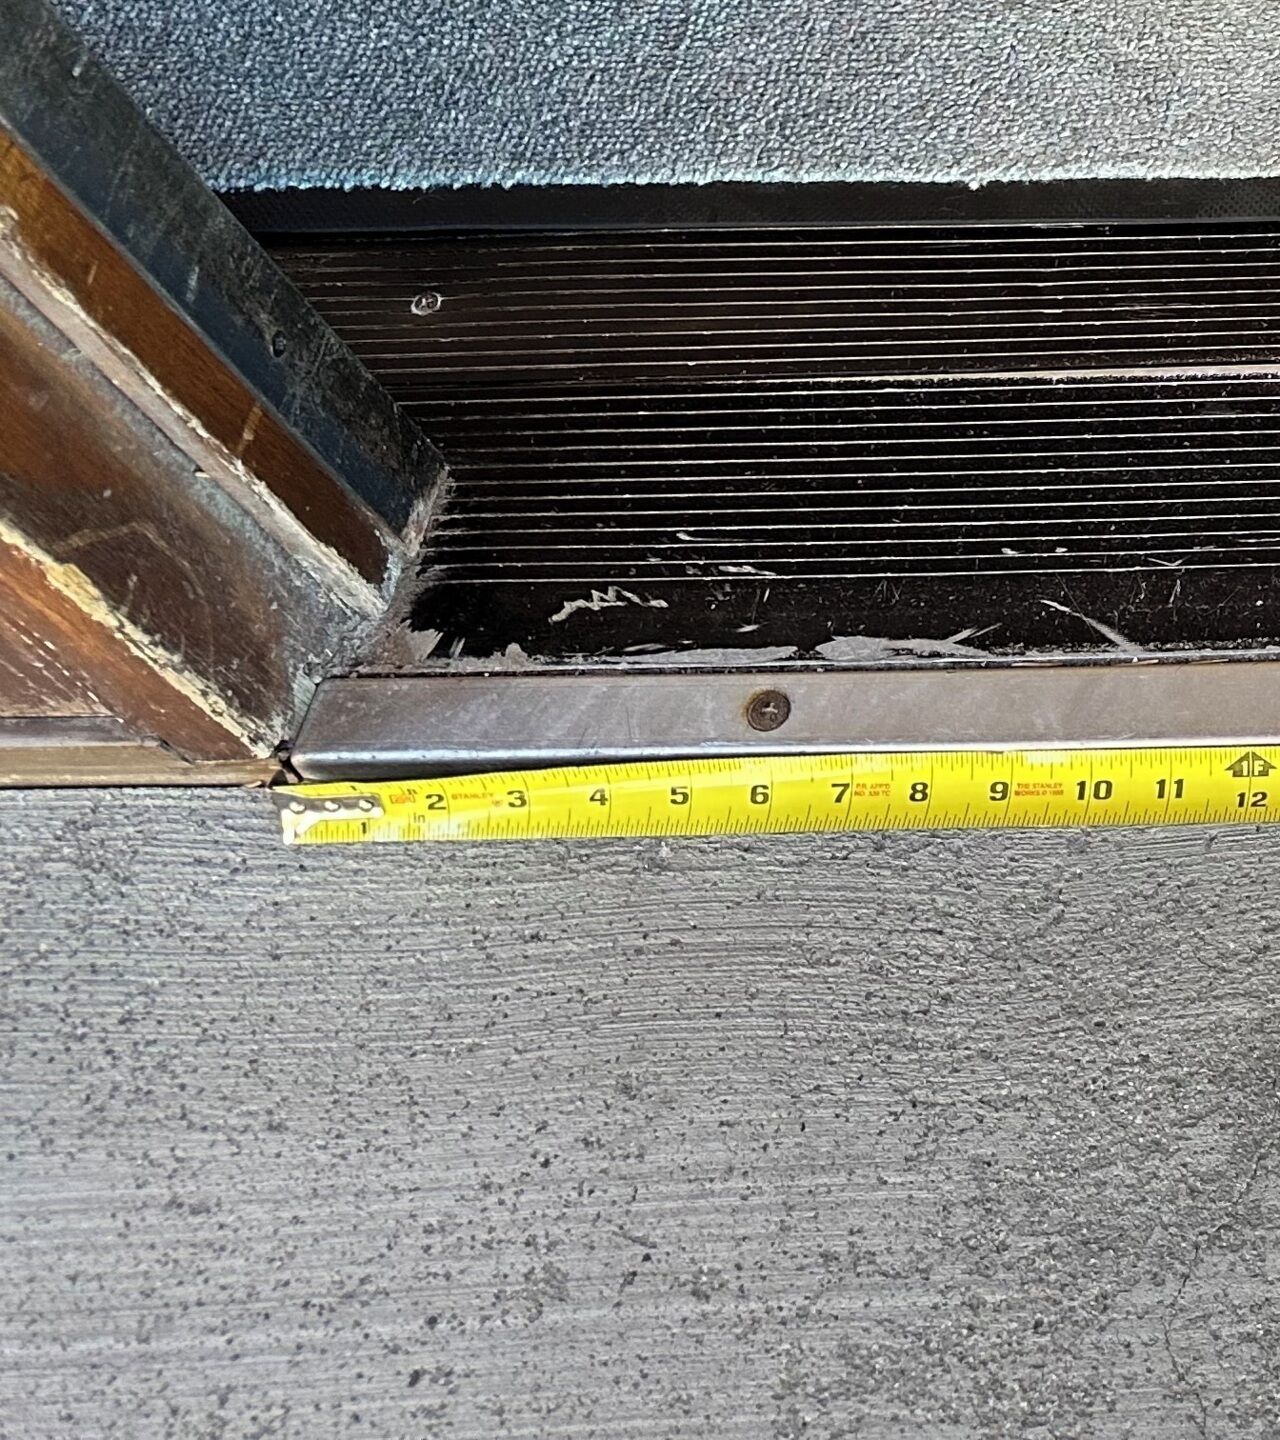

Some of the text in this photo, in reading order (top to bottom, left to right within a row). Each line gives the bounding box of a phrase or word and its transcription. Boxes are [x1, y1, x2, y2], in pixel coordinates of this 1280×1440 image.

[1239, 760, 1265, 777] 1F
[425, 793, 447, 810] 2
[506, 790, 527, 808] 3
[589, 788, 609, 806] 4
[670, 786, 690, 805] 5
[750, 784, 770, 804] 6
[831, 783, 850, 803] 7
[909, 782, 929, 802] 8
[989, 781, 1009, 801] 9
[1076, 780, 1113, 800] 10
[1155, 778, 1184, 799] 11
[1236, 792, 1268, 808] 12
